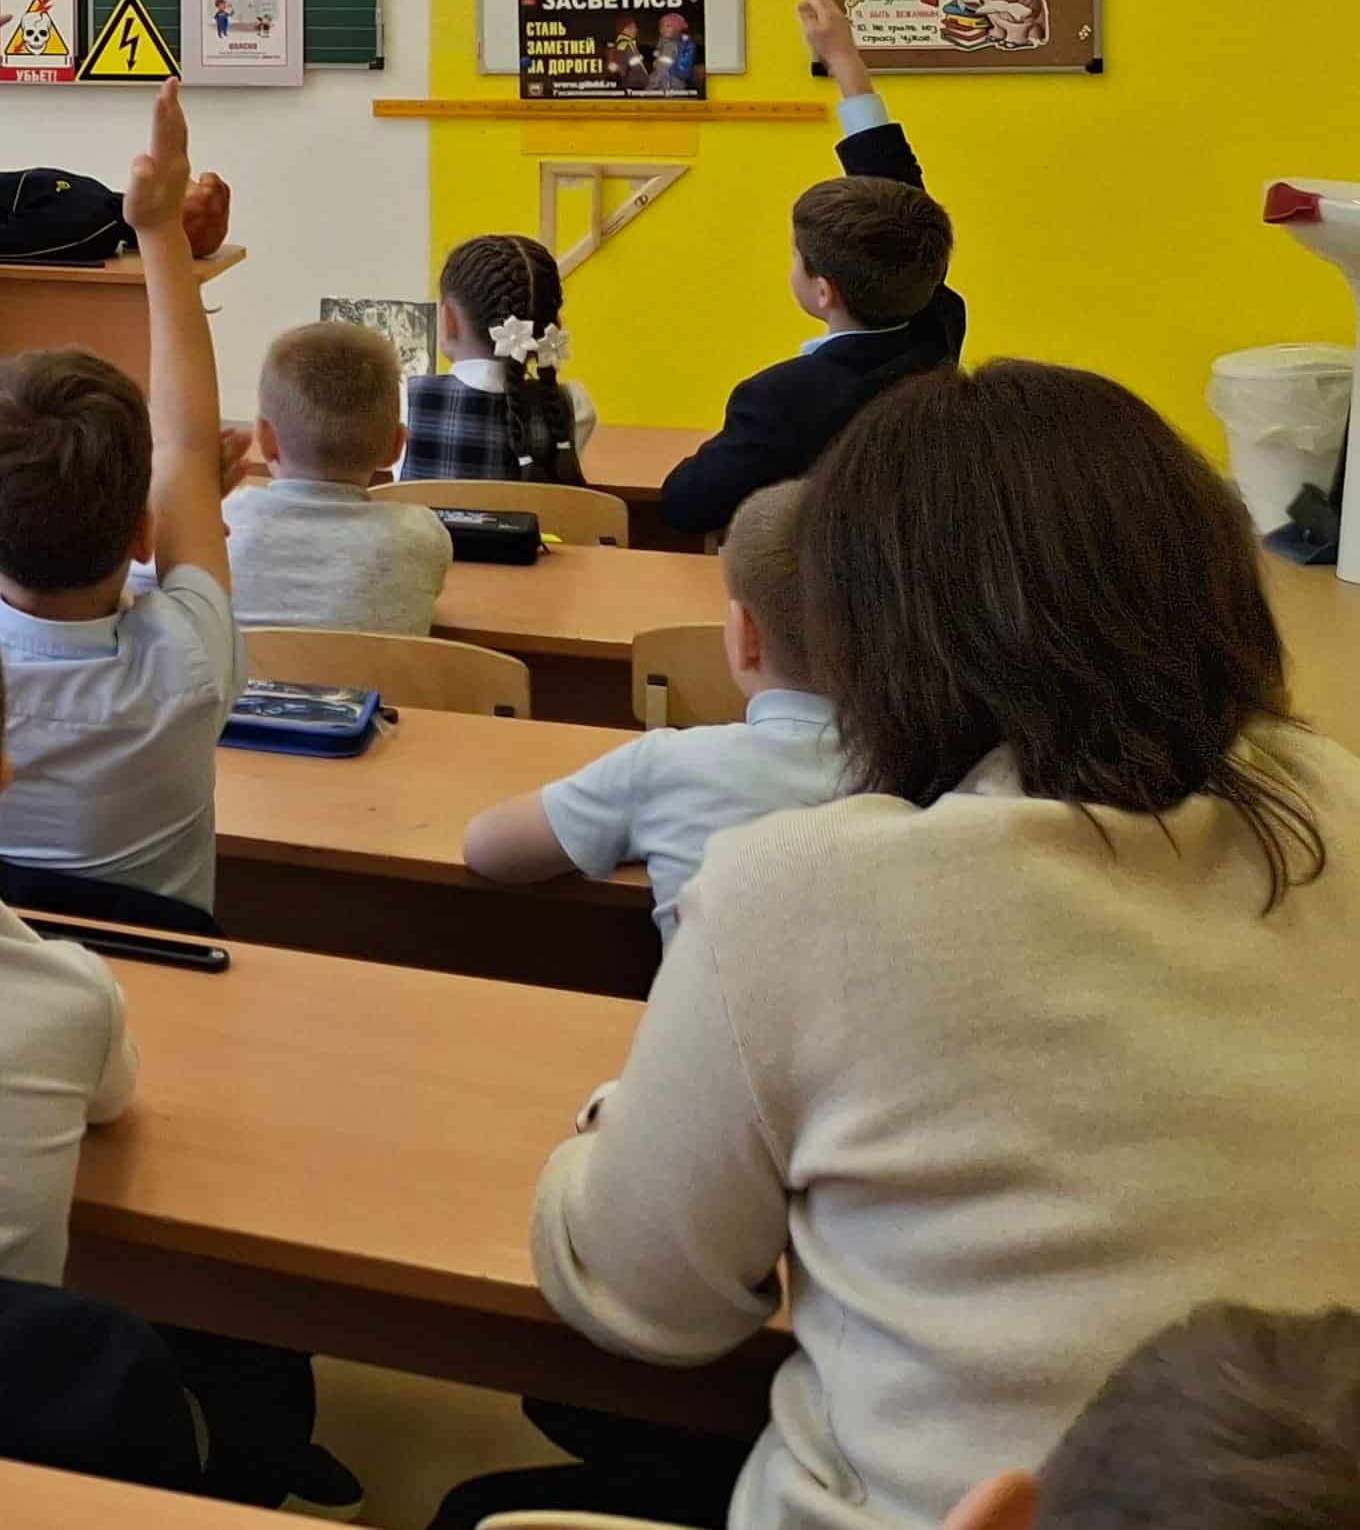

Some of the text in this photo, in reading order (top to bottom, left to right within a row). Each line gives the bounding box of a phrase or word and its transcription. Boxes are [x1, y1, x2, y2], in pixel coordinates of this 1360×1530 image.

[526, 21, 567, 37] СТАНЬ
[527, 37, 595, 56] ЗАМЕТНЕЙ
[548, 58, 604, 76] ДОРОГЕ!
